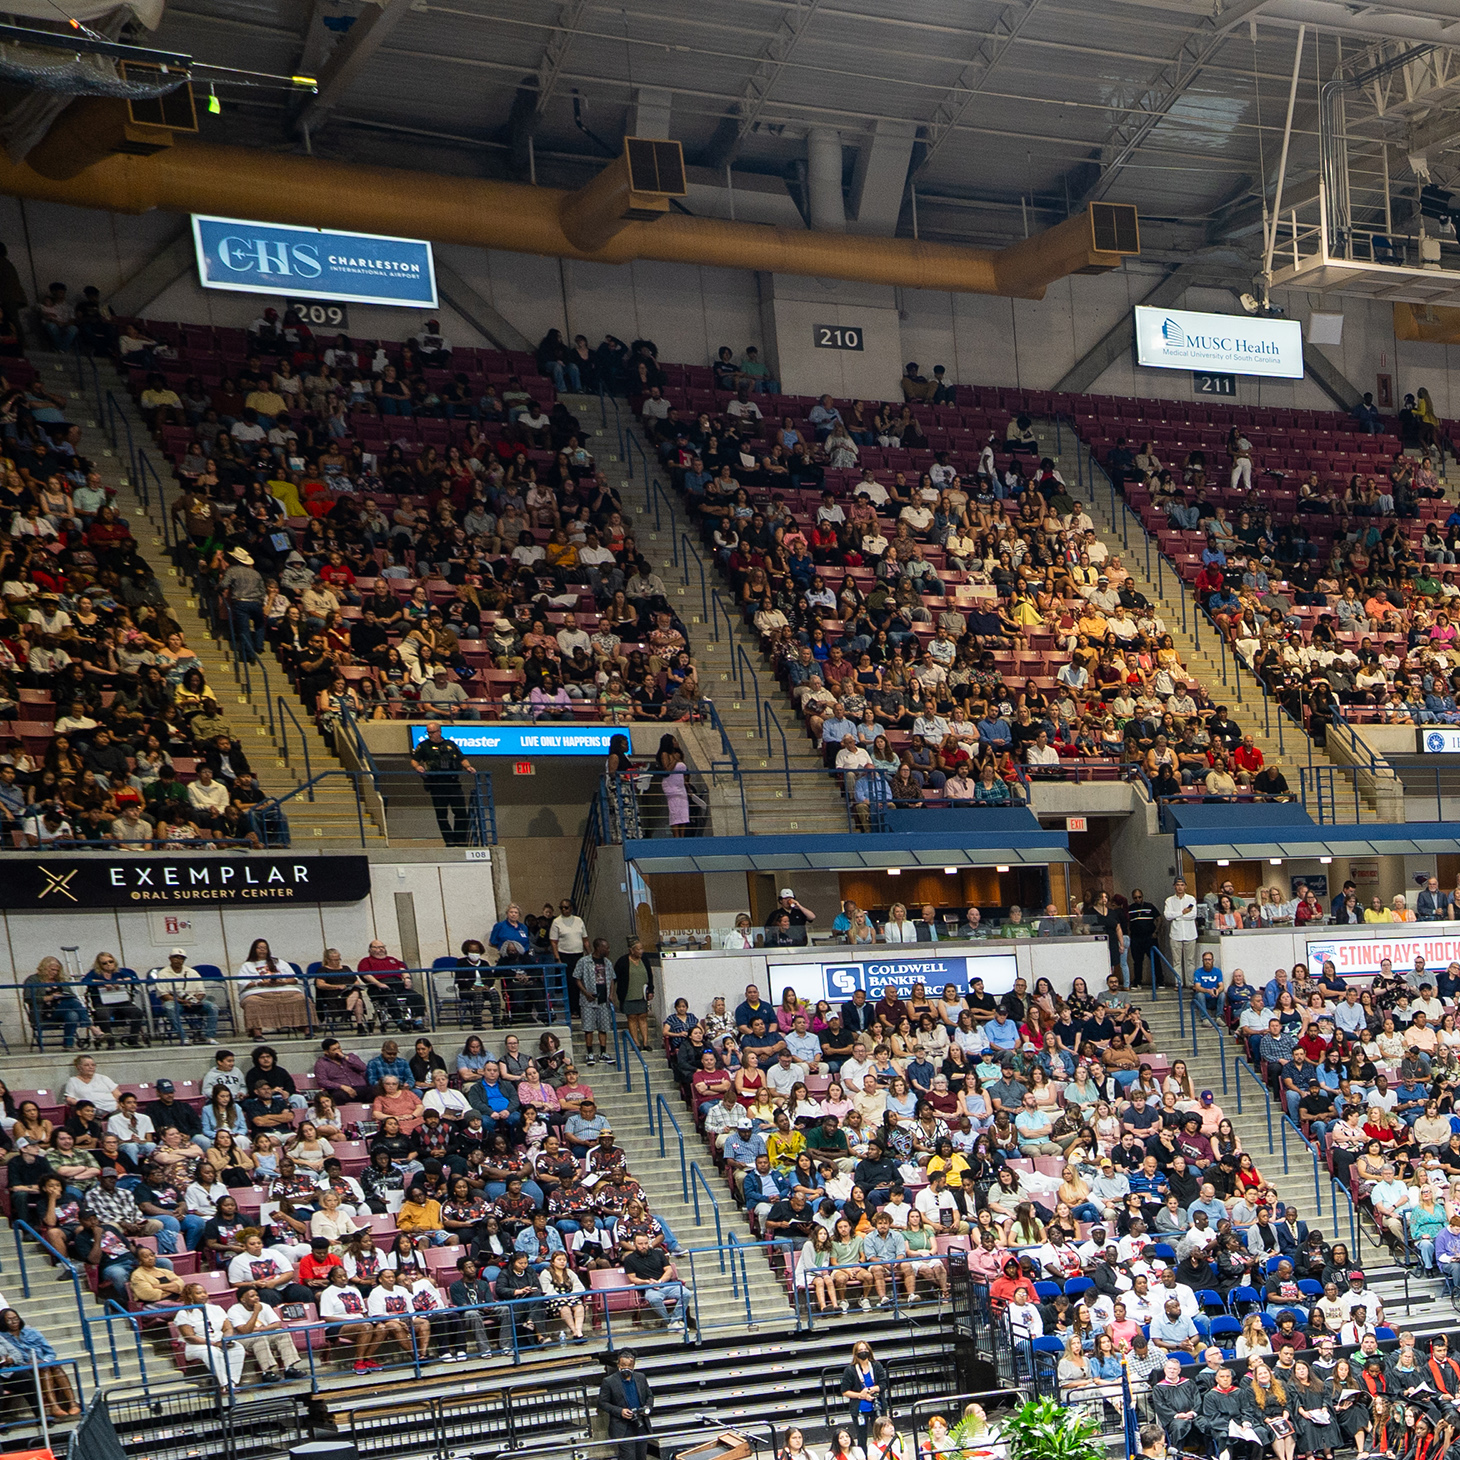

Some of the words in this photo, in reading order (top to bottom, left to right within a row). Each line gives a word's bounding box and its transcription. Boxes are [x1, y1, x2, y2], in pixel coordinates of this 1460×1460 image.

[218, 236, 322, 279] CHS
[328, 255, 421, 273] CHARLESTON
[330, 266, 388, 277] INTERNATIONAL
[389, 271, 420, 280] AIRPORT
[293, 303, 344, 326] 209
[820, 327, 858, 346] 210
[1186, 335, 1232, 351] MUSC
[1235, 339, 1280, 355] Health
[1163, 348, 1189, 357] Medical
[1190, 351, 1224, 361] University
[1225, 353, 1233, 361] of
[1233, 354, 1253, 362] South
[1254, 355, 1281, 364] Carolina
[1201, 376, 1230, 393] 211
[520, 736, 540, 747] LIVE
[540, 736, 562, 747] ONLY
[563, 736, 601, 747] HAPPENS
[516, 762, 531, 774] EXIT
[1070, 819, 1085, 830] EXIT
[470, 851, 486, 859] 108
[110, 865, 309, 887] EXEMPLAR
[130, 890, 169, 901] ORAL
[173, 889, 236, 900] SURGERY
[241, 887, 294, 898] CENTER
[1340, 943, 1420, 966] STINGRAYS
[868, 963, 948, 976] COLDWELL
[868, 974, 928, 987] BANKER
